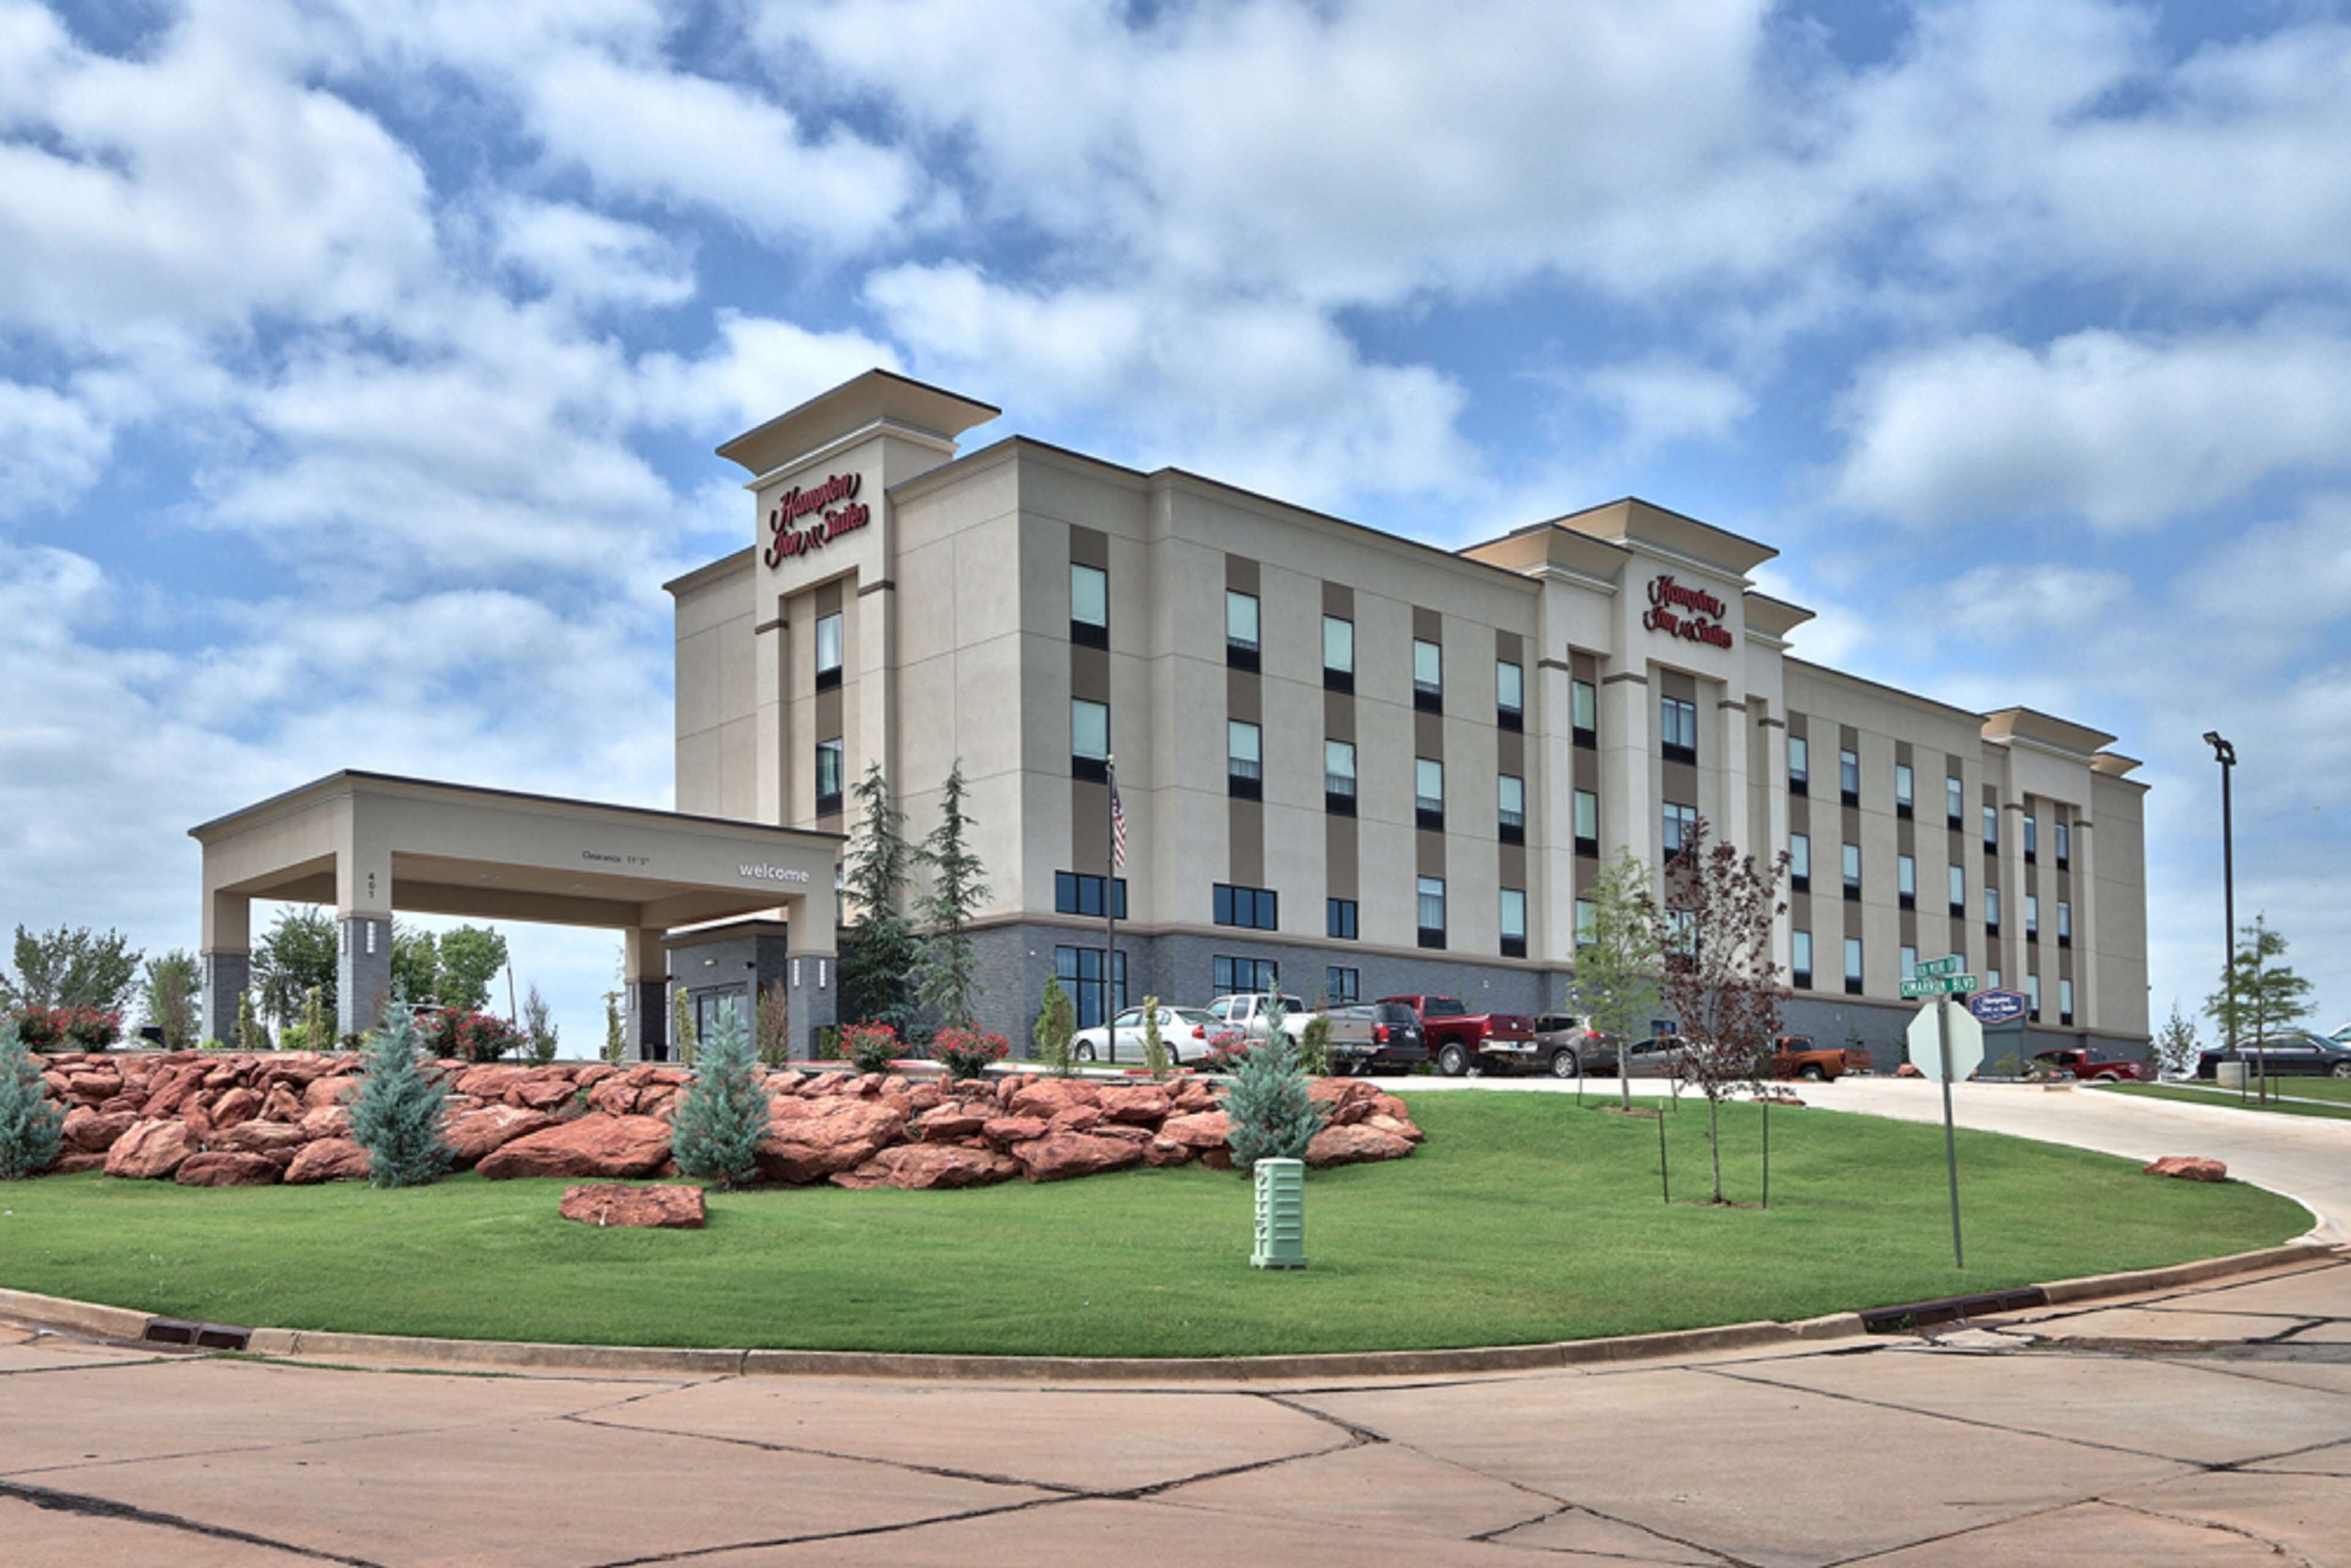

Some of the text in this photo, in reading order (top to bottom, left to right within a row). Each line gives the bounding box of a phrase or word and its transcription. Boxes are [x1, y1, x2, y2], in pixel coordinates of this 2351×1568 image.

[770, 472, 861, 535] Hampton
[764, 530, 808, 569] Inn
[819, 502, 870, 544] Suites
[1647, 575, 1726, 620] Hampton
[1642, 606, 1682, 637] Inn
[1693, 616, 1732, 649] Suites
[581, 850, 622, 864] Clearance
[739, 863, 809, 883] welcome
[1901, 976, 1976, 995] CIMARRON BLVD
